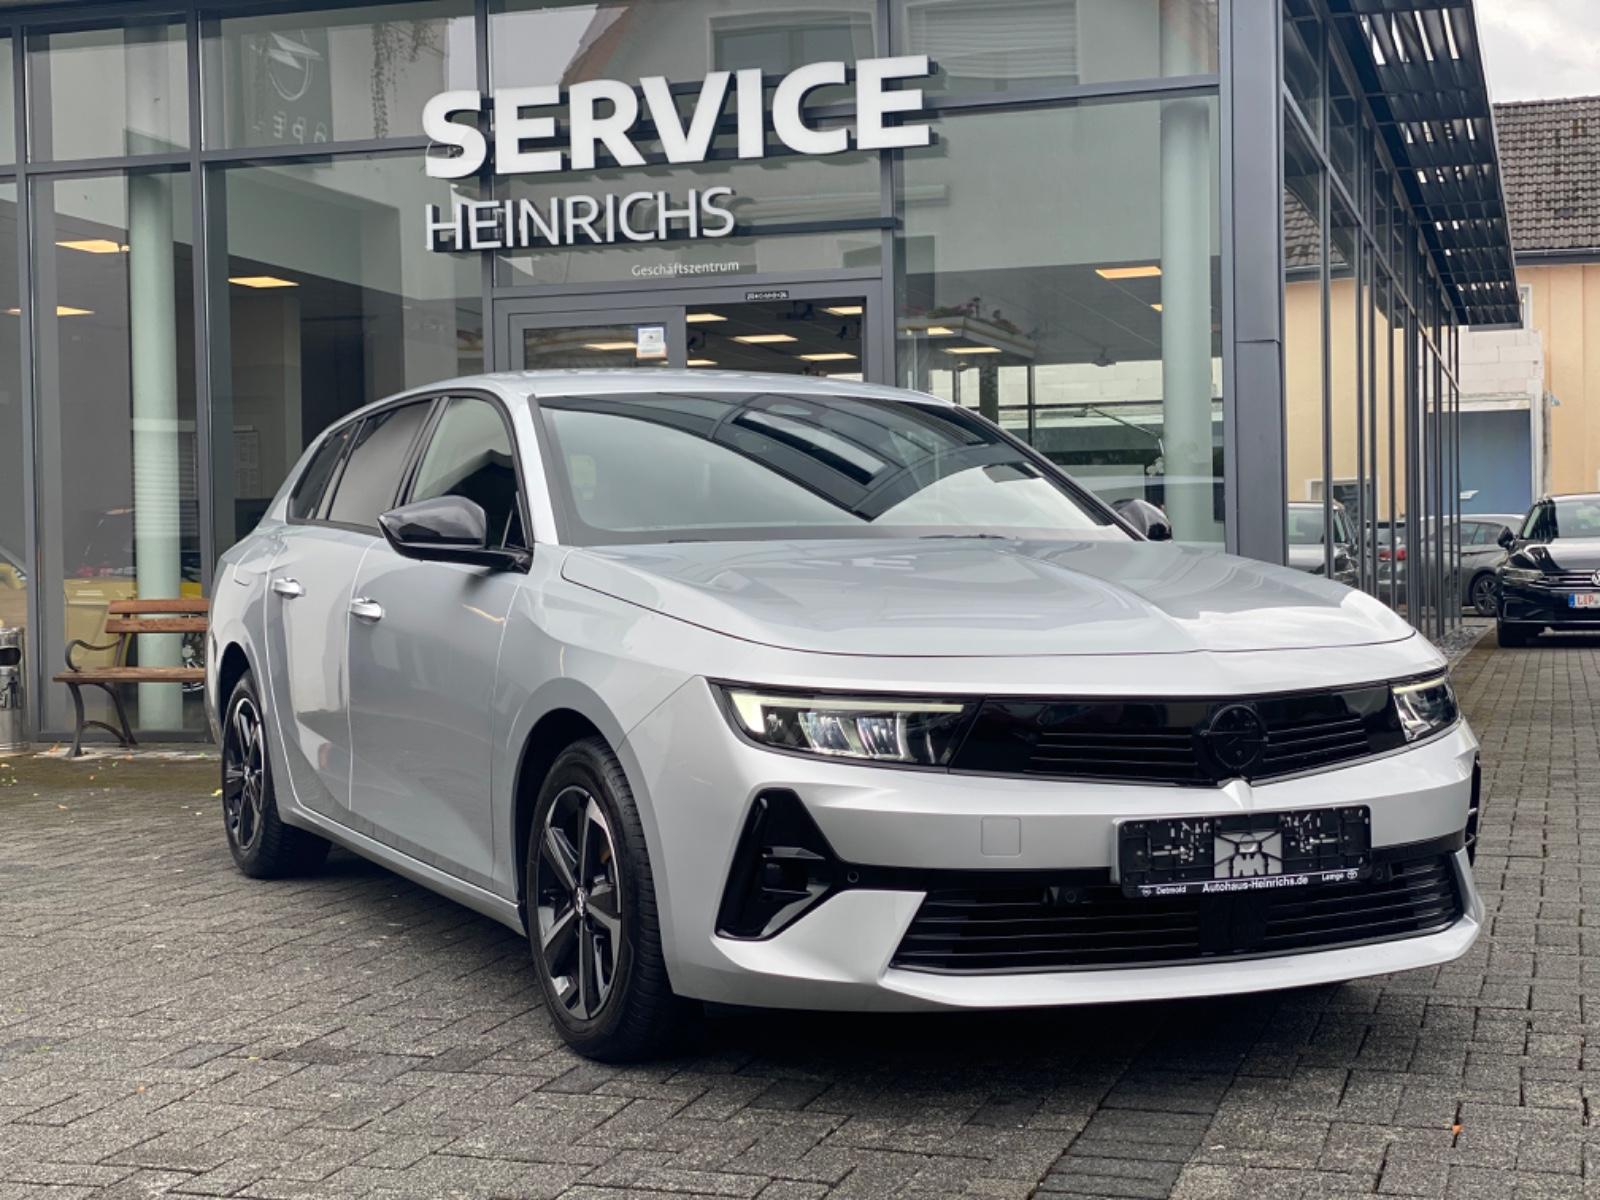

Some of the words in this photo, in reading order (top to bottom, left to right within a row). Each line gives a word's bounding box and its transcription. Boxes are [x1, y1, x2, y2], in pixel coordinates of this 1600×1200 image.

[421, 54, 932, 180] SERVICE
[424, 186, 737, 251] HEINRICHS
[631, 261, 740, 277] Geschäftszentrum
[1202, 873, 1309, 893] Autohaus-Heinrichs.de
